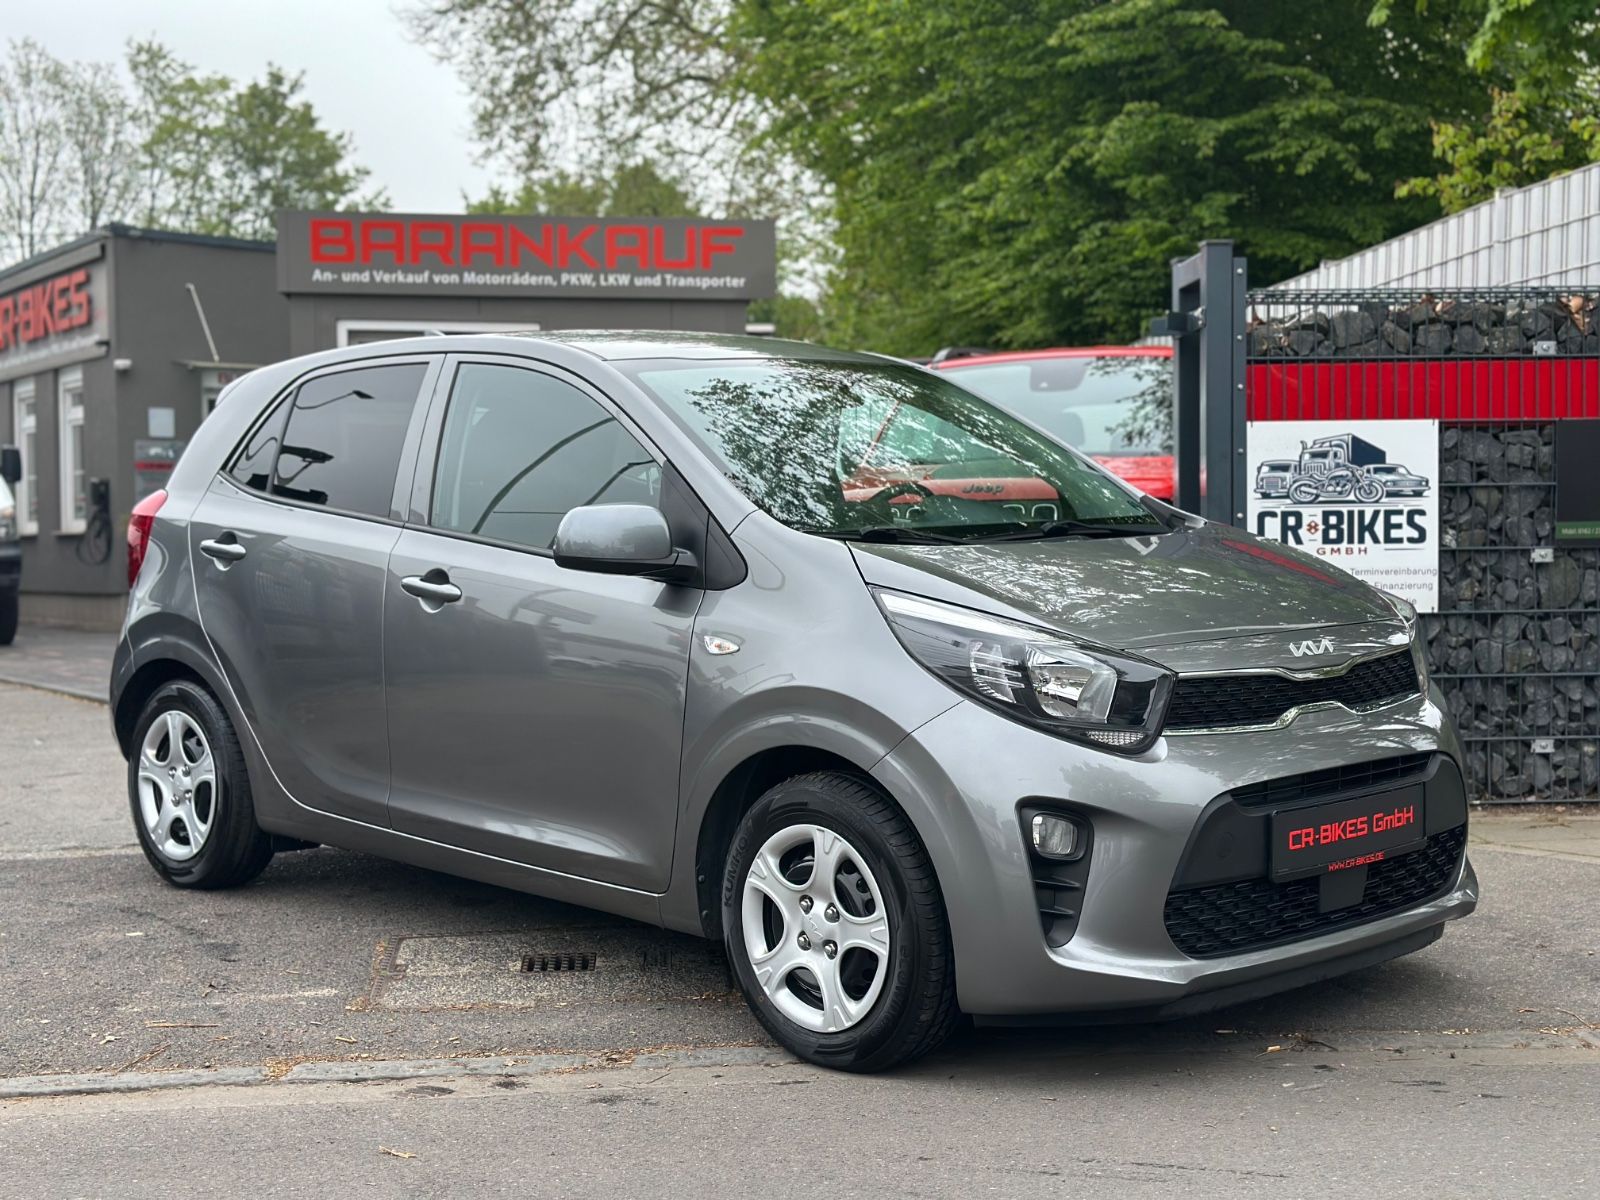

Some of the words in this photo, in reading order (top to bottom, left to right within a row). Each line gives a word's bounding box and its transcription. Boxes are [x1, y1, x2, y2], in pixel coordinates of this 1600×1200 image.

[310, 219, 745, 270] BARANKAUF
[312, 269, 337, 282] An-
[342, 269, 370, 283] und
[373, 270, 429, 284] Verkauf
[433, 273, 459, 284] von
[463, 270, 557, 287] Motorrädern,
[561, 273, 596, 287] PKW,
[600, 273, 631, 286] LKW
[634, 273, 661, 287] und
[664, 273, 746, 290] Transporter
[962, 482, 1004, 495] Jeep
[1322, 509, 1427, 545] BIKES
[1316, 547, 1368, 556] GMBH
[1350, 567, 1438, 577] Terminvereinbarung
[1288, 816, 1369, 850] CR-BIKES
[1373, 805, 1414, 833] GmbH
